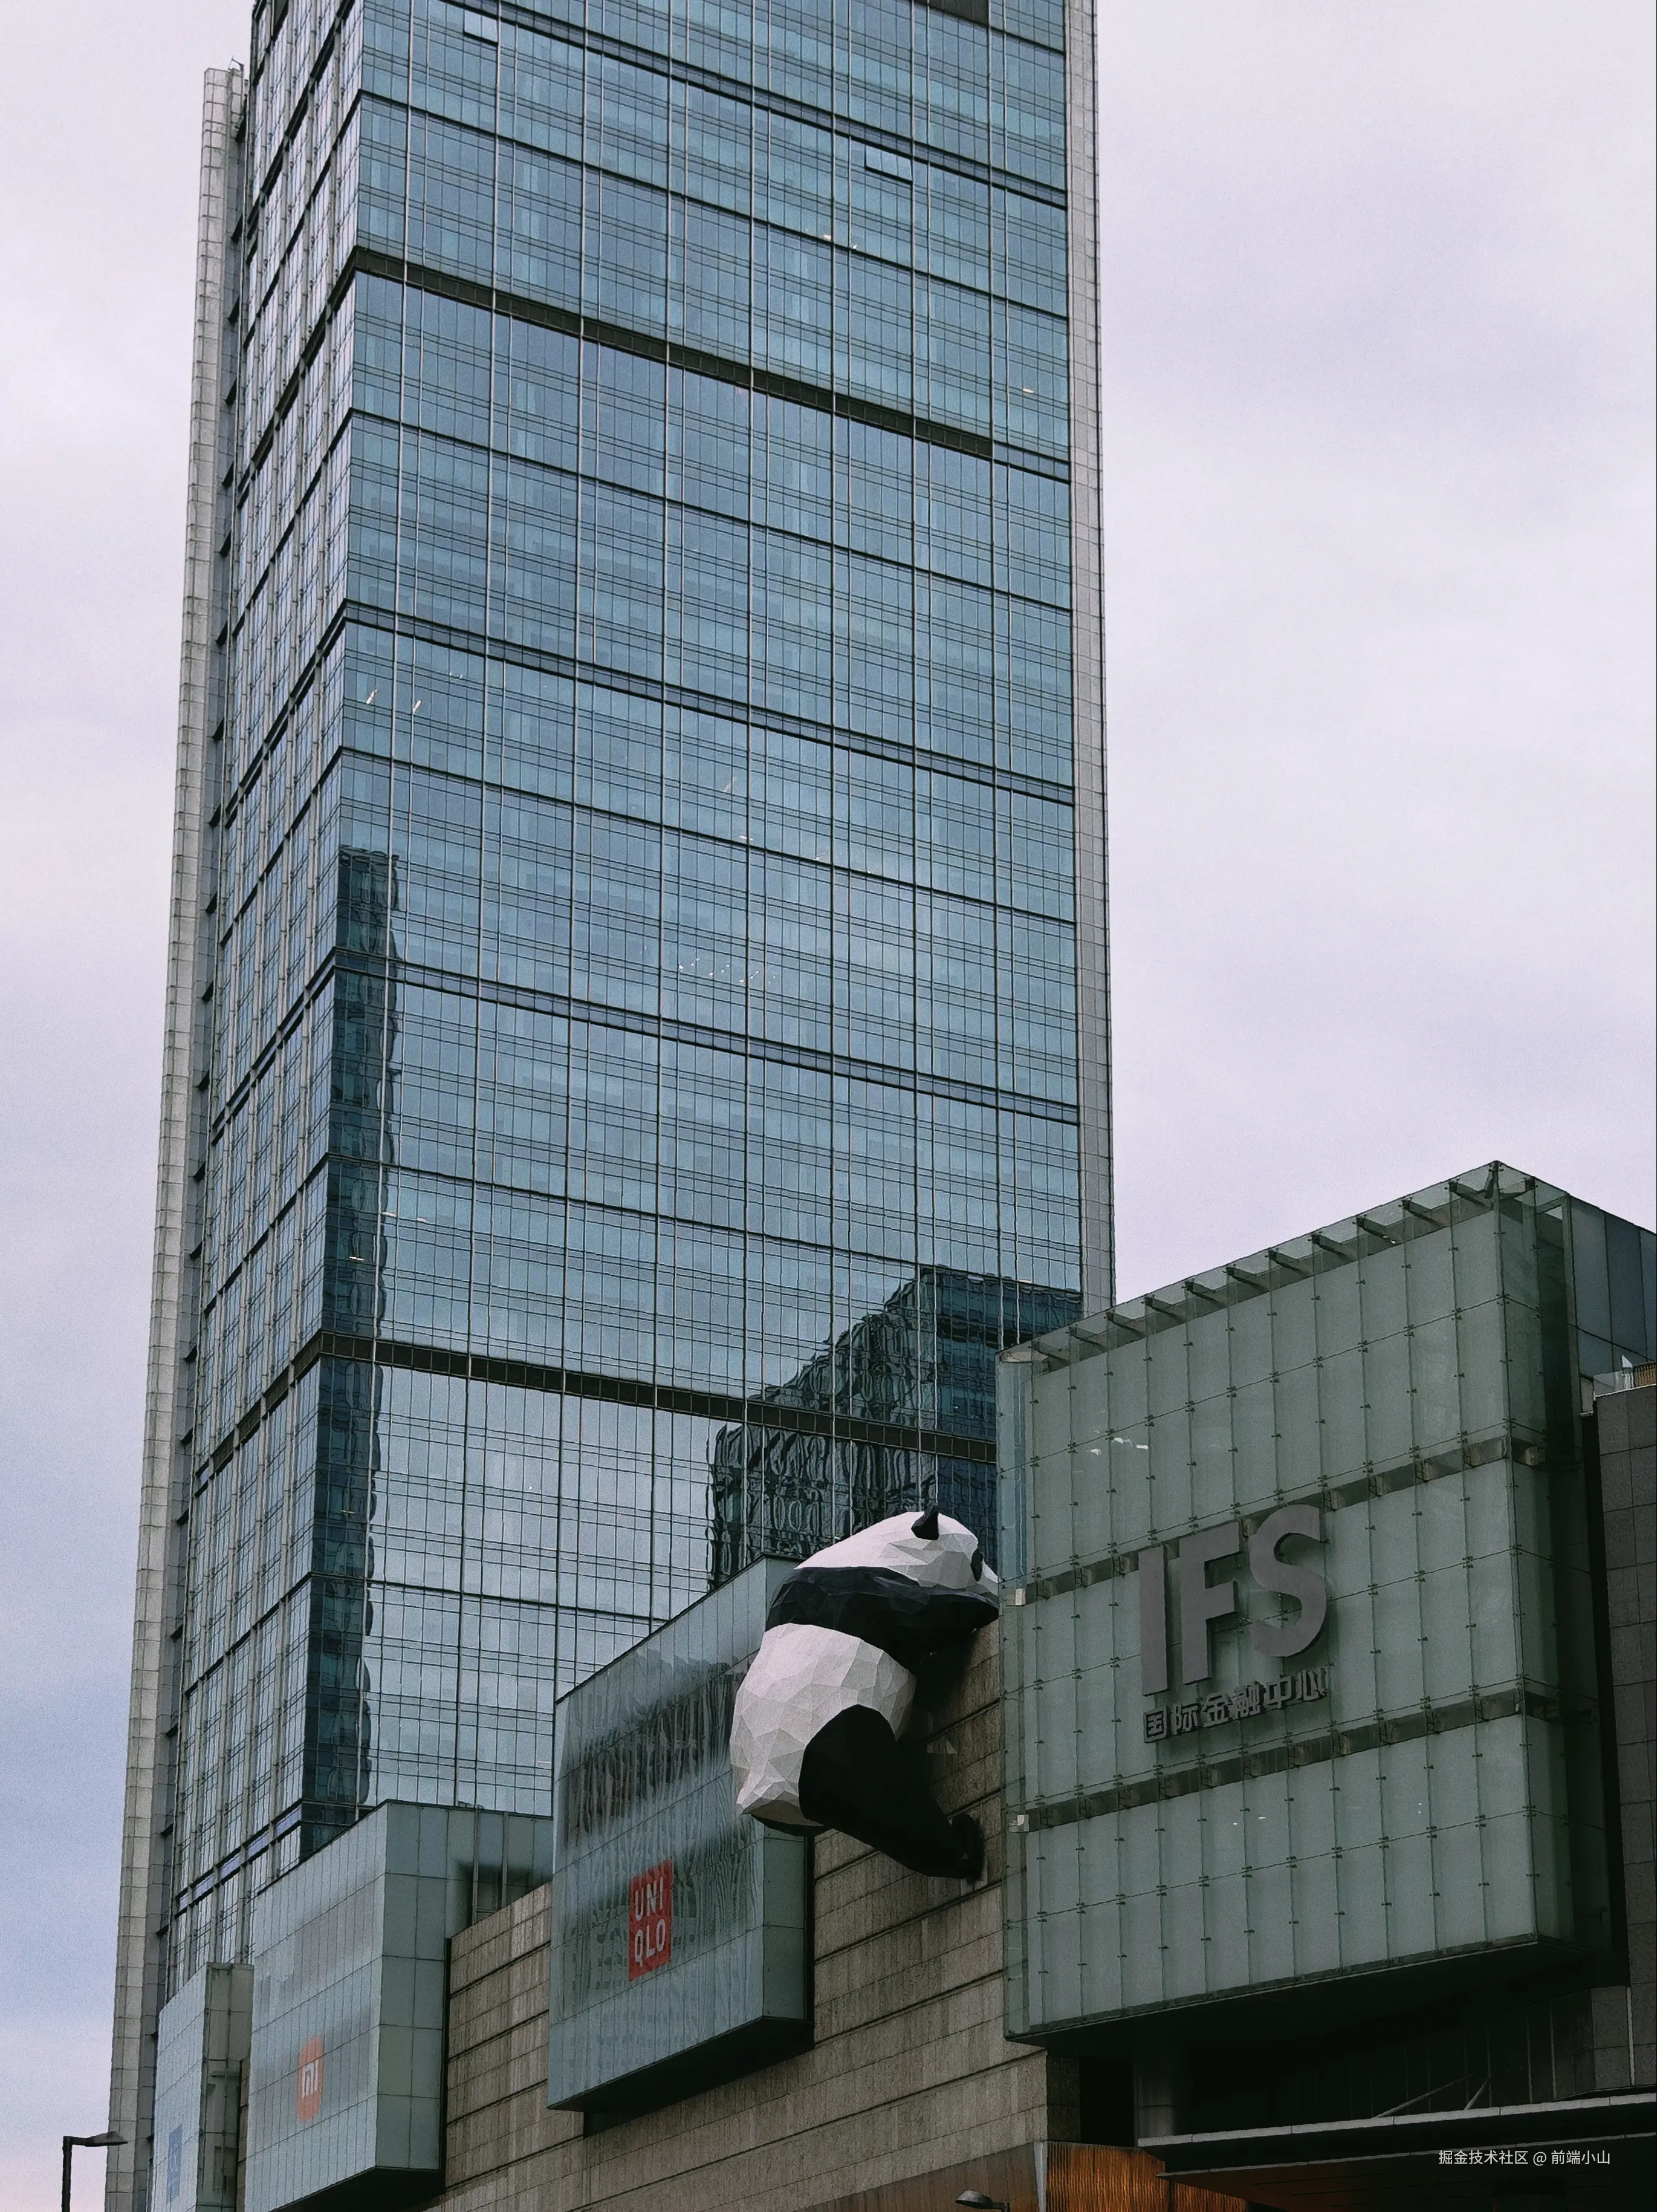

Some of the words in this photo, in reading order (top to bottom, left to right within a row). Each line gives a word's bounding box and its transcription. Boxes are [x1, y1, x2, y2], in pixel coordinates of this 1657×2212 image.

[1138, 1504, 1328, 1697] IFS
[1143, 1667, 1330, 1743] 国际金融中心
[635, 1876, 664, 1921] UNI
[634, 1918, 666, 1968] QLO
